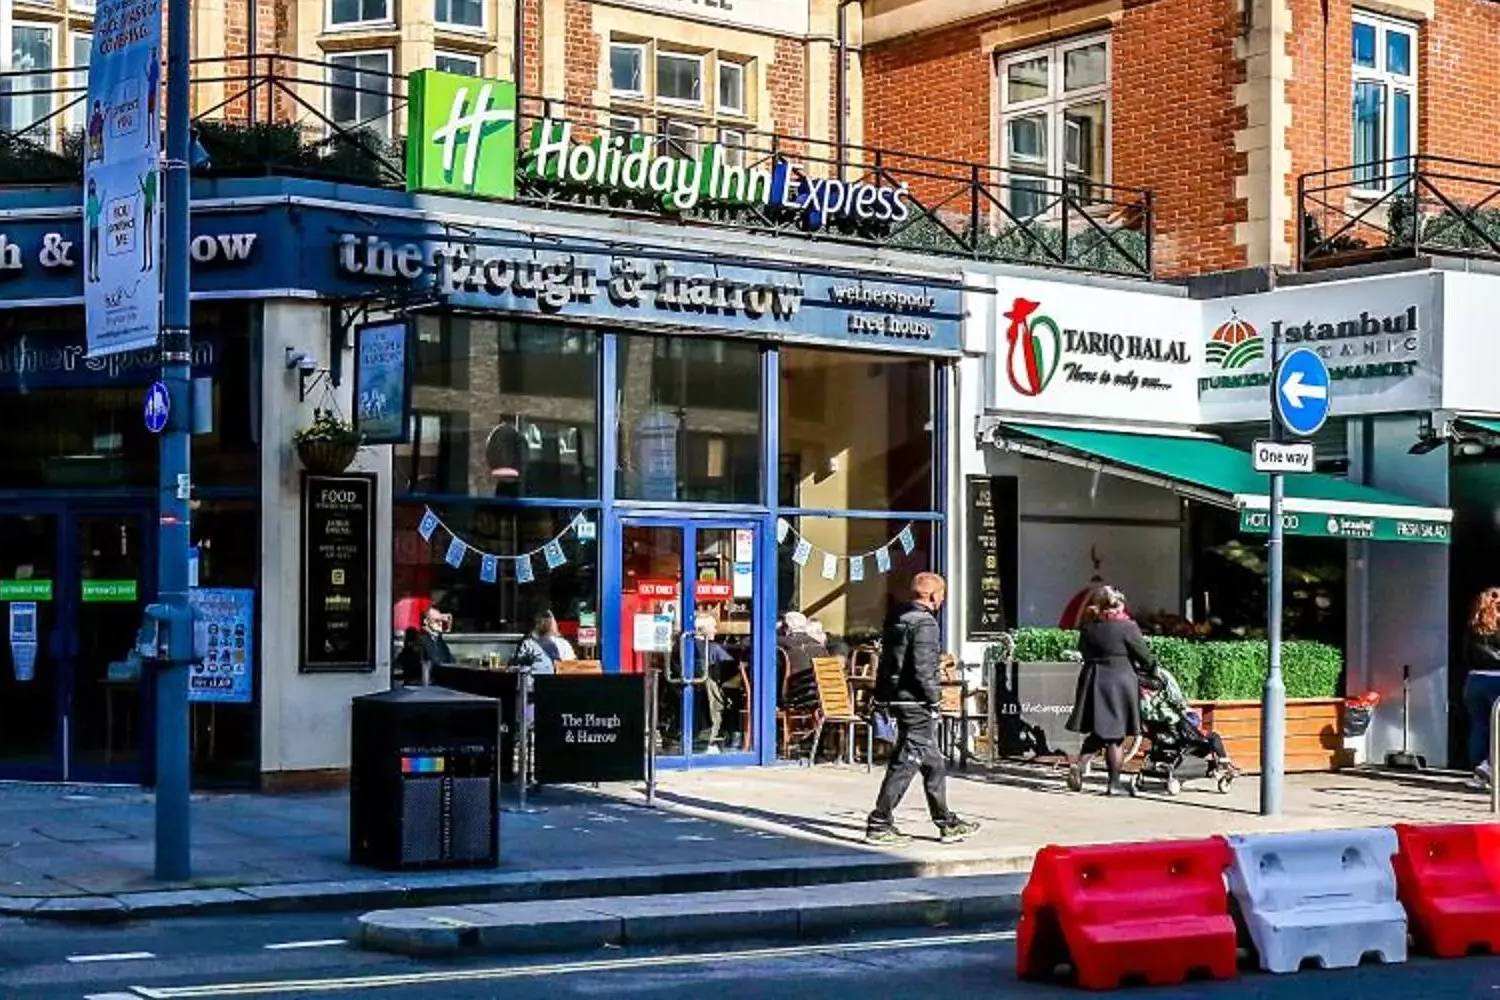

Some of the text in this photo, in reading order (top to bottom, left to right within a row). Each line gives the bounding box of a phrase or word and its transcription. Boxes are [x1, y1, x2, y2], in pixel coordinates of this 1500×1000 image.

[534, 119, 909, 225] Holiday Inn Express
[38, 233, 75, 268] &
[339, 233, 802, 318] the plough & harrow
[1271, 304, 1419, 343] Istanbul
[1063, 330, 1190, 364] TARIQ HALAL
[1259, 448, 1309, 466] One way
[321, 489, 357, 503] FOOD
[1246, 514, 1268, 528] HOT
[561, 713, 620, 729] The Plough
[565, 729, 616, 743] & Harrow
